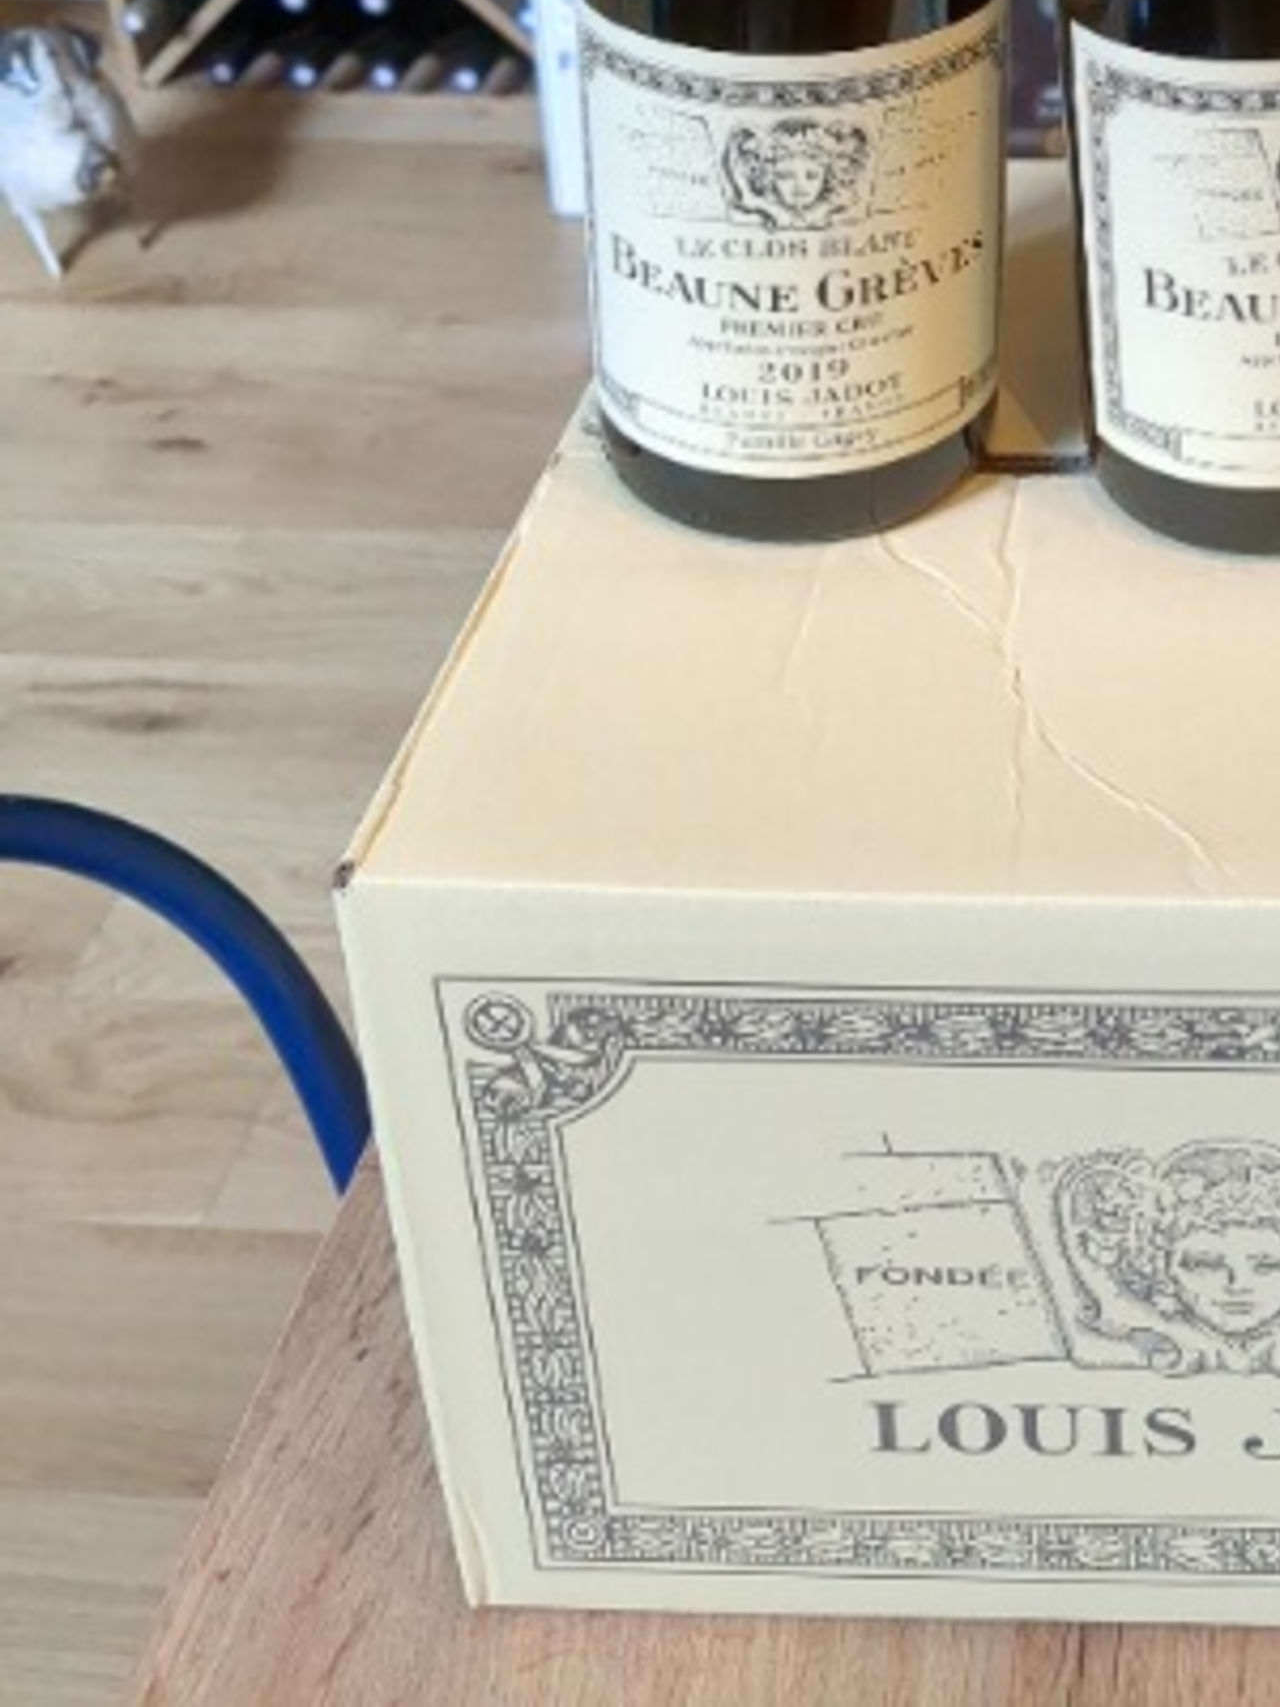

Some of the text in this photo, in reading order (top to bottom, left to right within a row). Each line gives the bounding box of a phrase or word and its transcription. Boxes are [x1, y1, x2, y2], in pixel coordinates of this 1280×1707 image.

[610, 231, 799, 313] BEAUNE
[758, 359, 849, 382] 2019
[869, 1400, 1198, 1456] LOUIS
